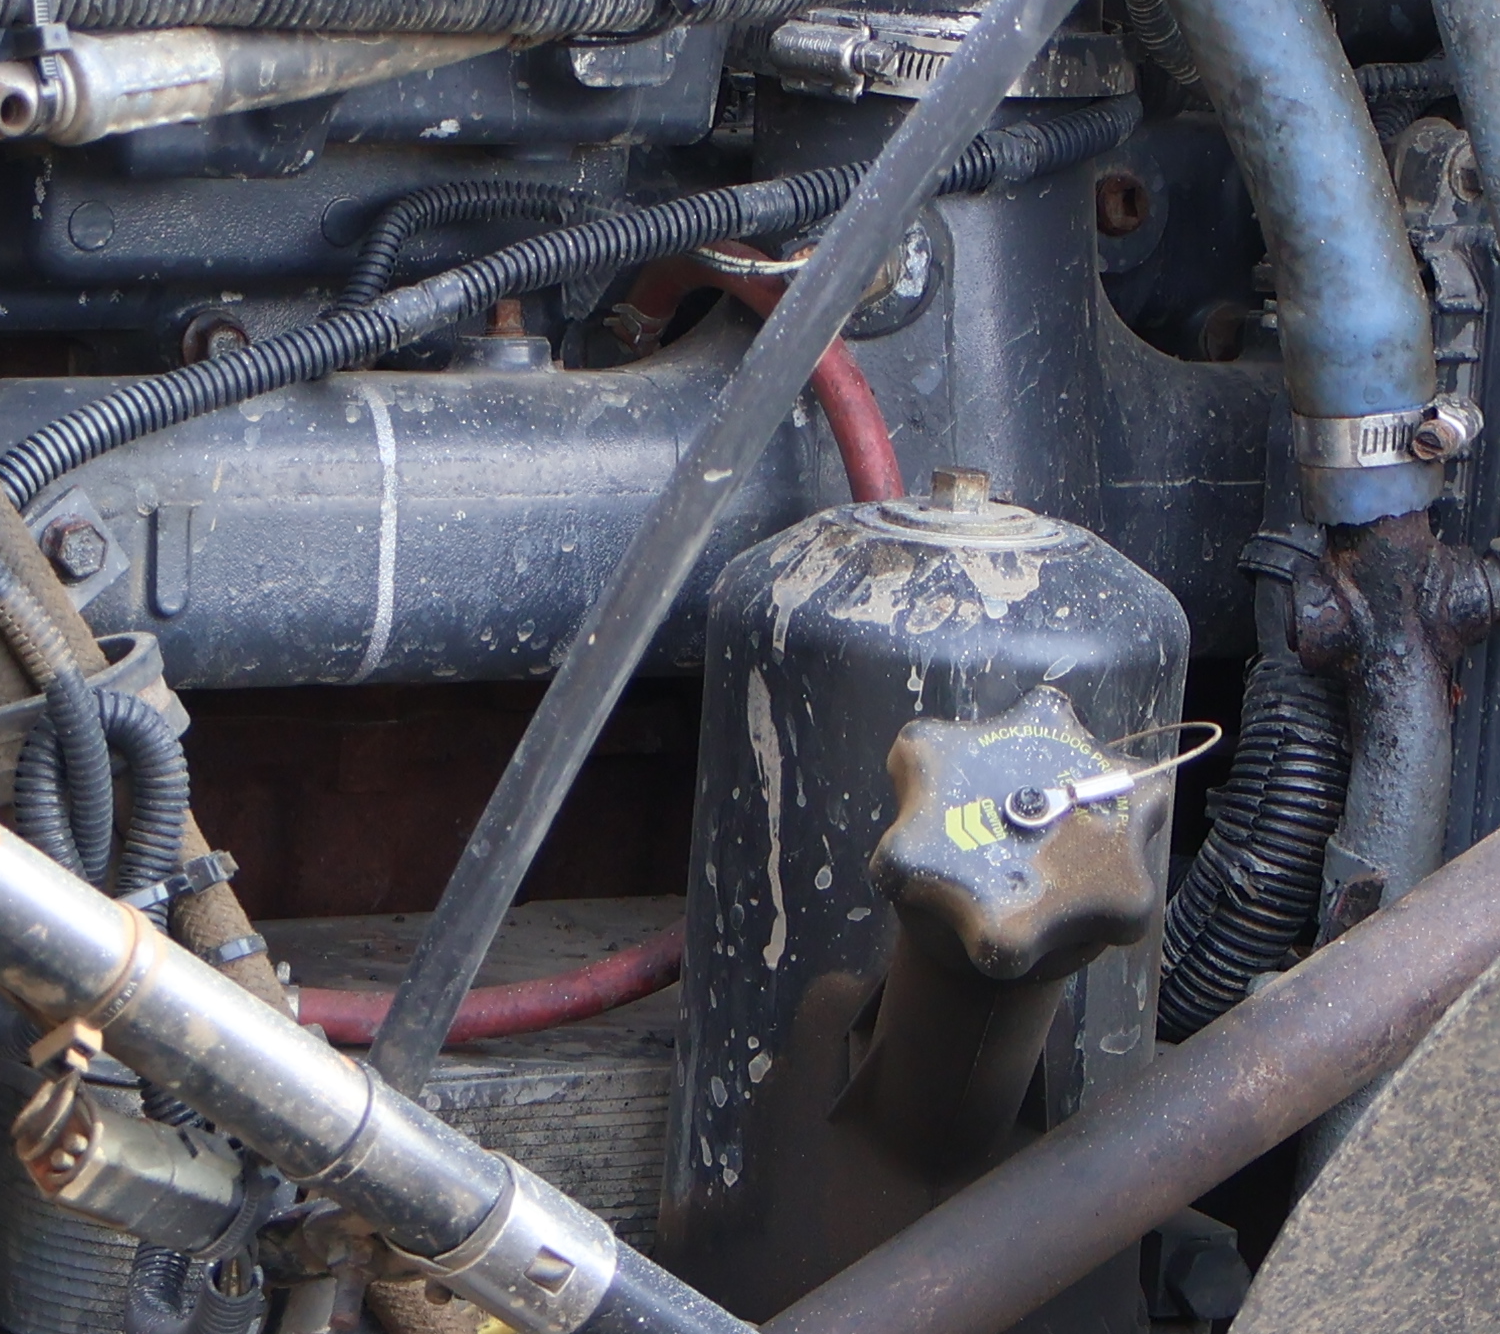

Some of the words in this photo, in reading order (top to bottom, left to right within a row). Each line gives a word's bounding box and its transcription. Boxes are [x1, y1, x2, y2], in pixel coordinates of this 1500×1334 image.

[977, 725, 1019, 748] MACK
[1022, 724, 1092, 756] BULLDOG
[981, 797, 1008, 841] Chevron
